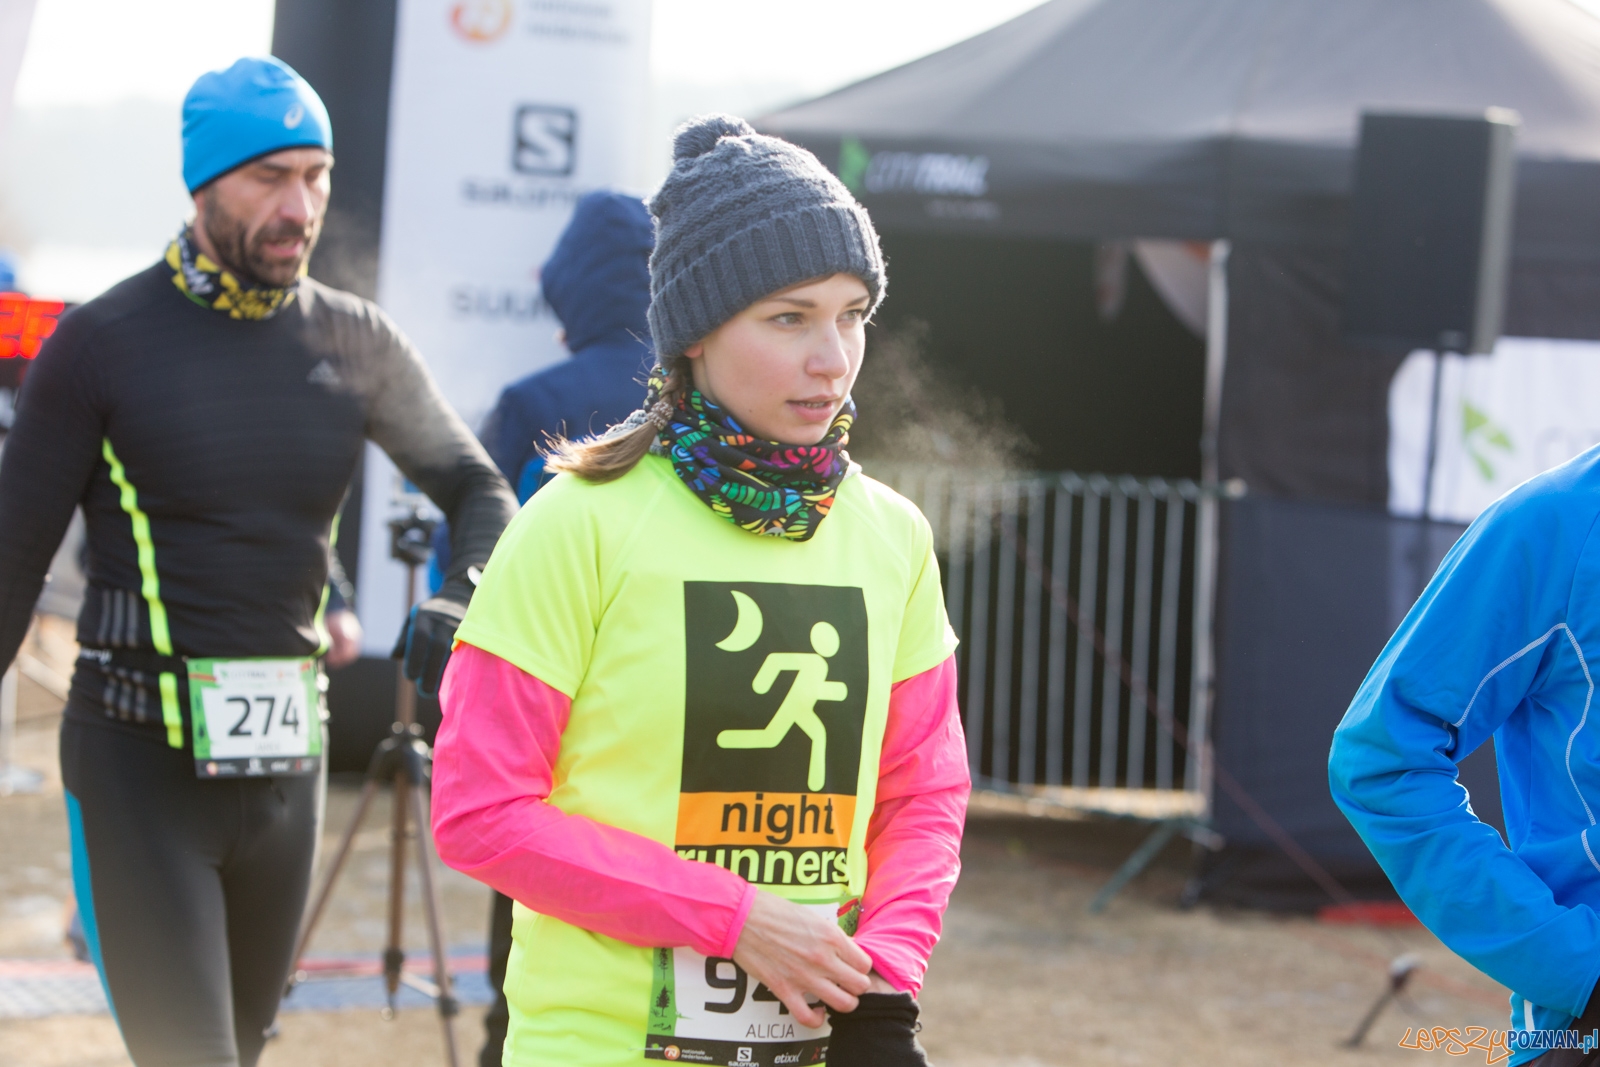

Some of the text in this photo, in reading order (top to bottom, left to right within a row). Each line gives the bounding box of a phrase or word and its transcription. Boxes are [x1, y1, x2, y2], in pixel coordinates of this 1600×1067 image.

[225, 696, 299, 736] 274
[720, 793, 835, 845] night
[745, 1023, 796, 1039] ALICJA
